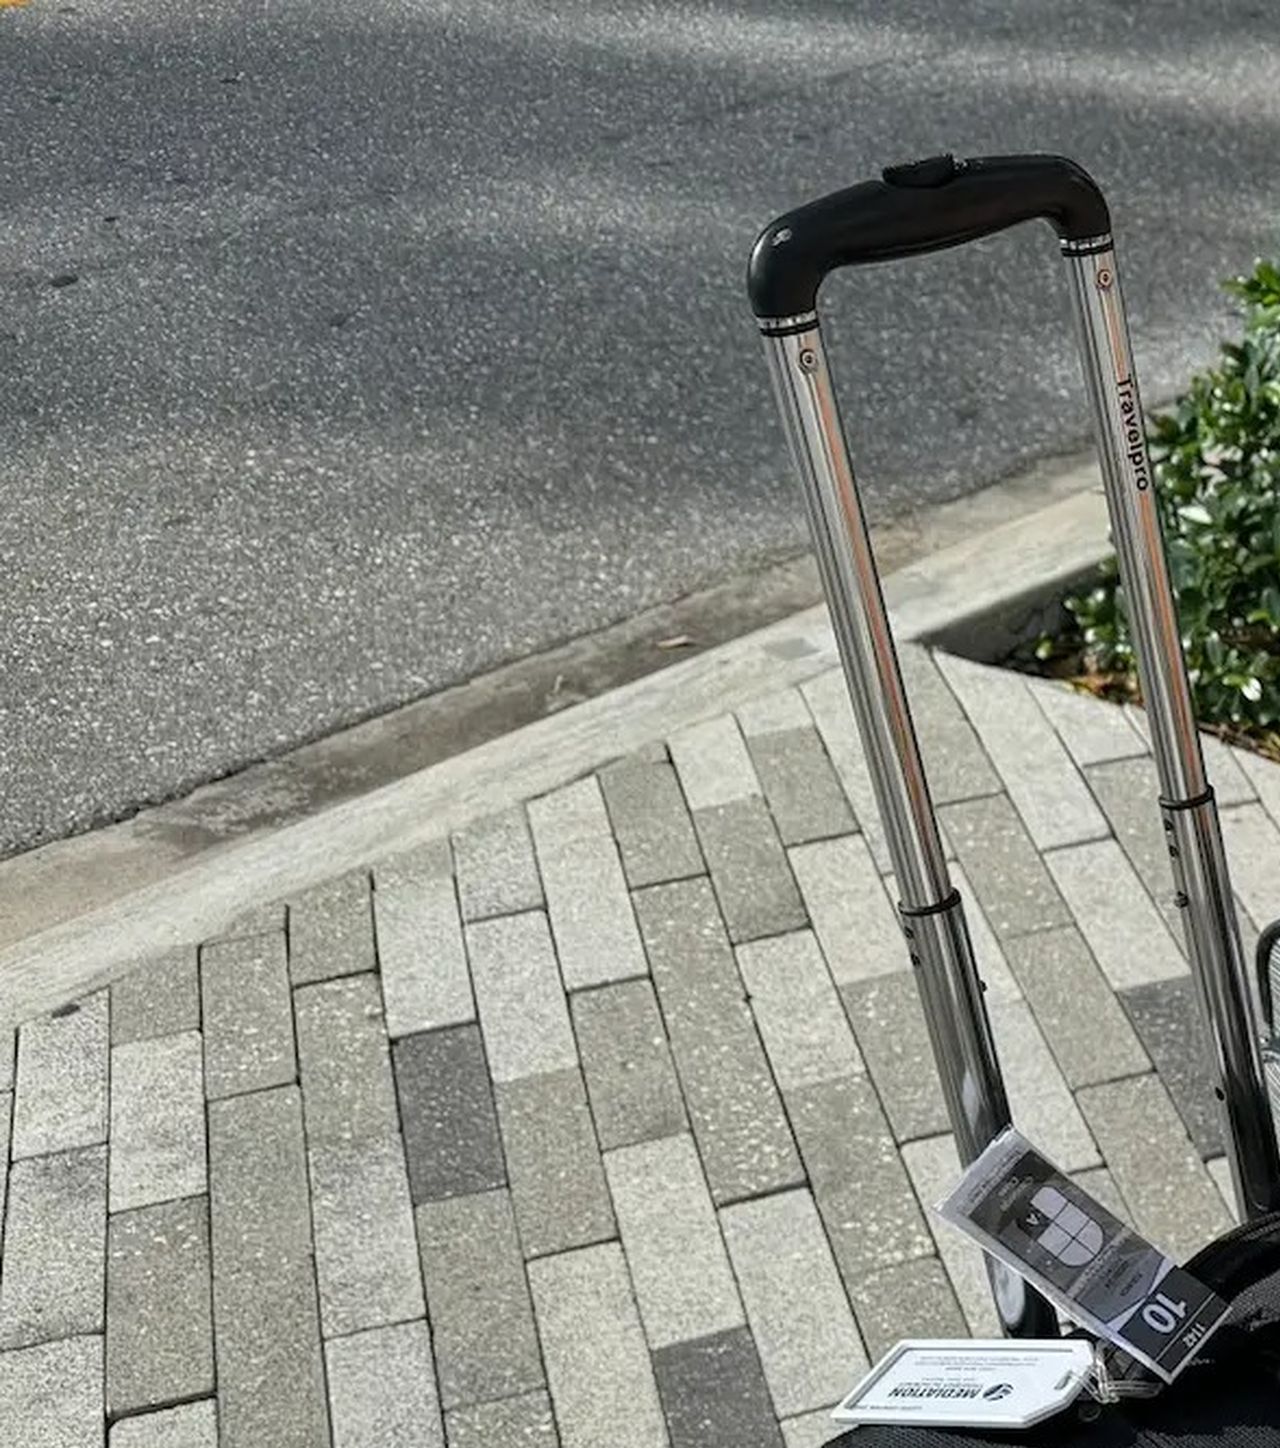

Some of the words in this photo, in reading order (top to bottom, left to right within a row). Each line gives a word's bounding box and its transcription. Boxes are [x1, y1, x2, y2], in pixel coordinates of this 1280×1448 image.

[1115, 373, 1150, 492] Travelpro
[1141, 1292, 1188, 1335] 10
[1182, 1322, 1208, 1350] 1142
[888, 1386, 983, 1400] MEDIATION
